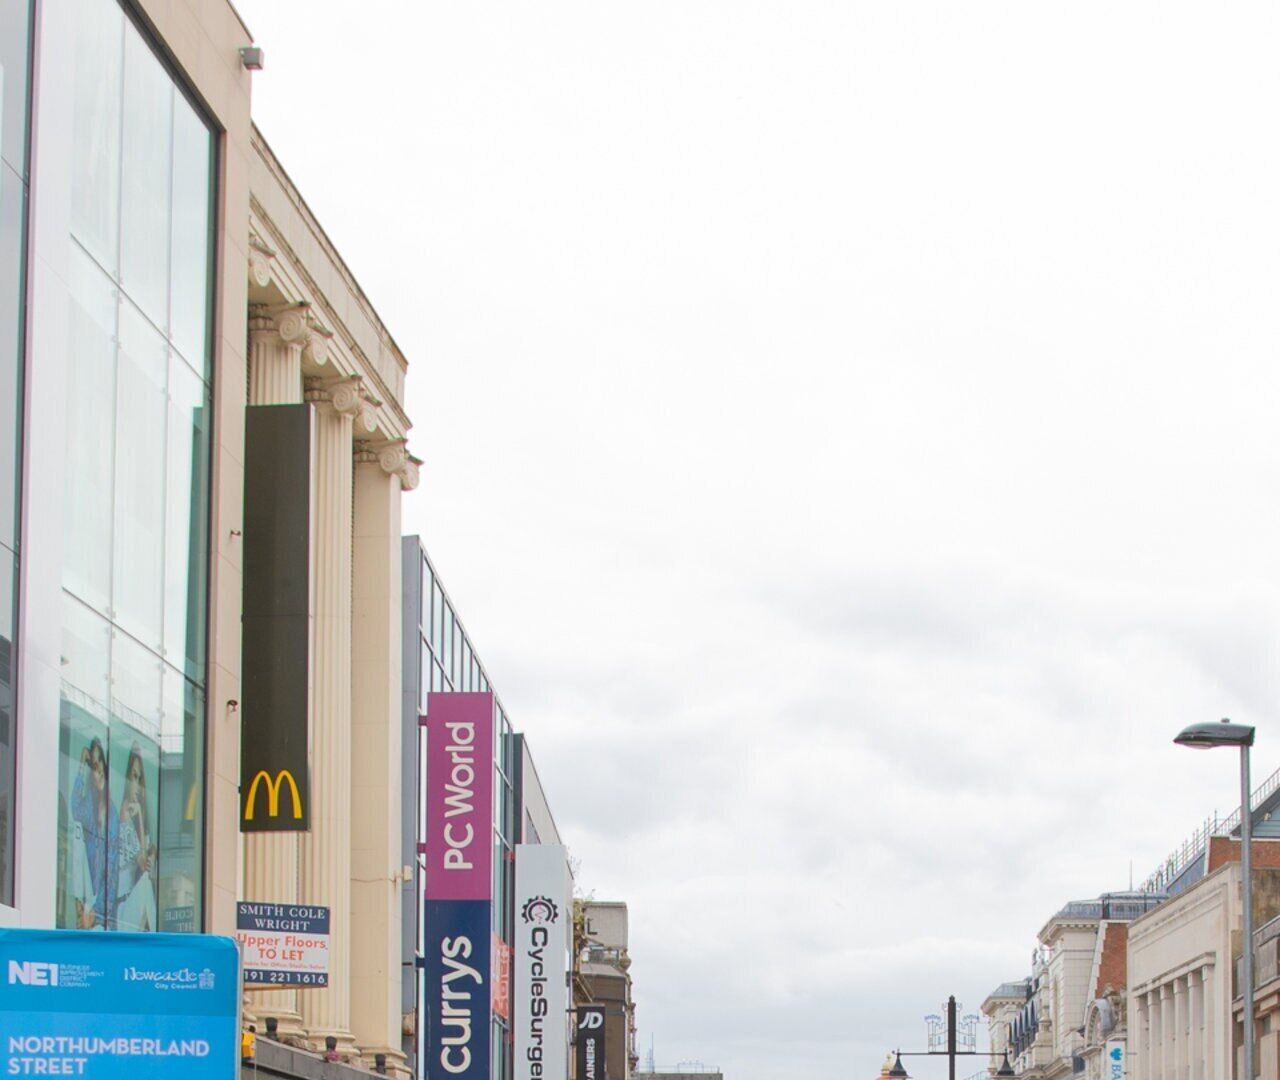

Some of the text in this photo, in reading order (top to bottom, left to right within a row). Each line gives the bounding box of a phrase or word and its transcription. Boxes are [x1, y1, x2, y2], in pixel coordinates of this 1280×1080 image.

[443, 721, 475, 870] PC World
[239, 904, 325, 919] SMITH COLE
[255, 918, 310, 931] WRIGHT
[237, 933, 326, 948] Upper Floors
[258, 948, 304, 961] TO LET
[8, 960, 58, 986] NE1
[124, 967, 197, 982] Newcastle
[244, 971, 325, 984] 191 221 1616
[440, 935, 483, 1074] currys
[579, 1011, 603, 1029] JD
[8, 1036, 209, 1057] NORTHUMBERLAND
[7, 1057, 87, 1075] STREET
